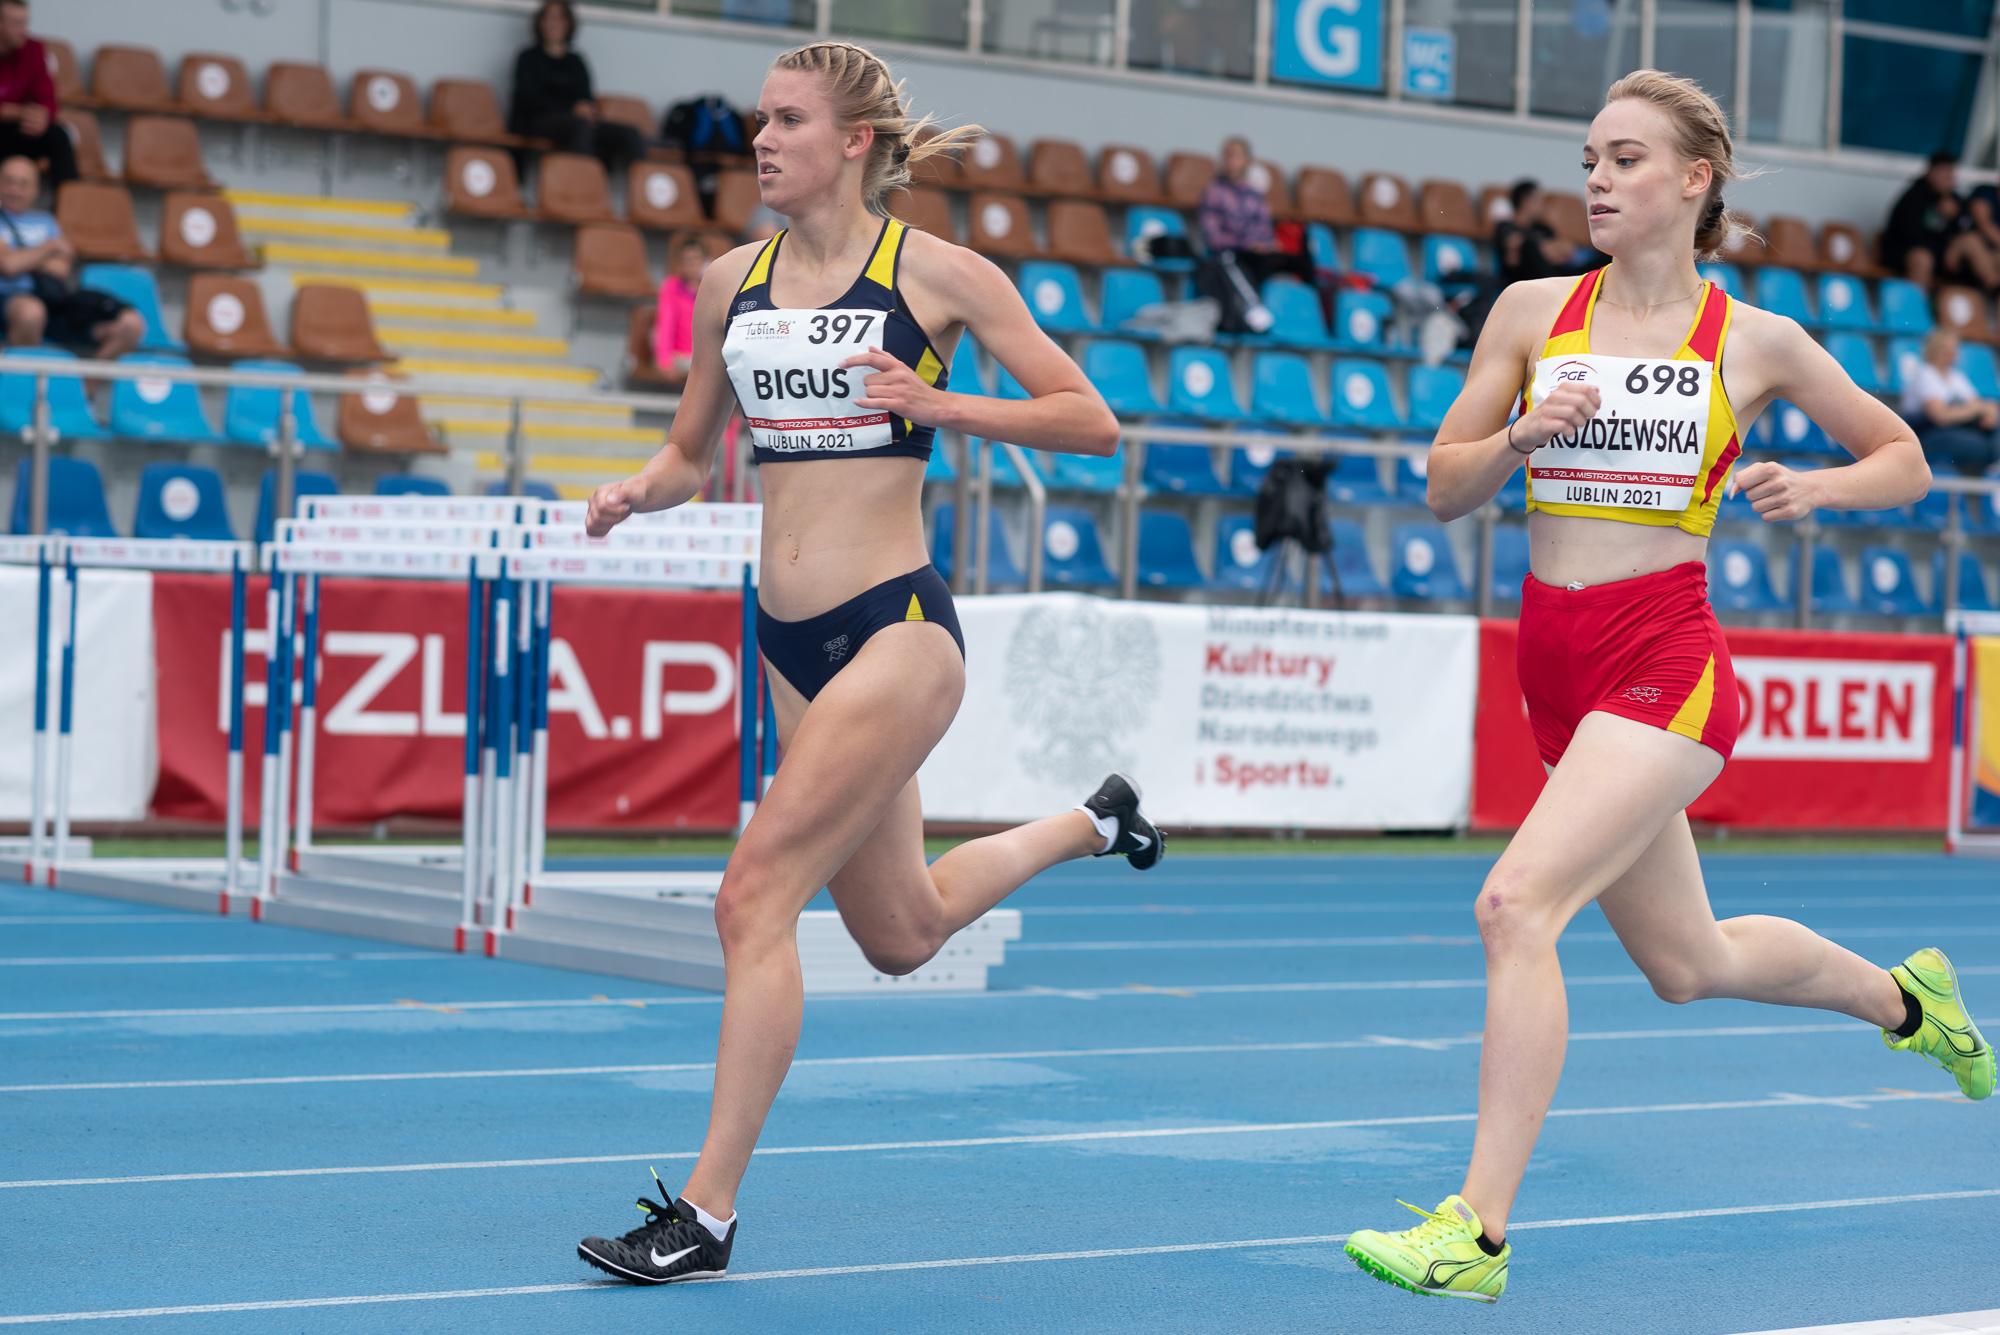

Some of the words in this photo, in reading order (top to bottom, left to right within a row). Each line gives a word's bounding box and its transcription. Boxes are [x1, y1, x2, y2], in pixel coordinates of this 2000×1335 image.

[1293, 0, 1361, 78] G
[807, 315, 876, 345] 397
[753, 368, 851, 400] BIGUS
[1557, 371, 1588, 382] PGE
[1625, 364, 1700, 397] 698
[832, 418, 862, 427] POLSKI
[864, 415, 883, 424] U20
[1536, 410, 1699, 454] ROZDŻEWSKA
[768, 435, 811, 449] LUBLIN
[817, 433, 854, 449] 2021
[1538, 470, 1552, 478] 75.
[1575, 472, 1639, 482] MISTRZOSTWA
[1640, 475, 1675, 484] POLSKI
[1676, 477, 1695, 485] U20
[1566, 486, 1618, 503] LUBLIN
[1623, 489, 1661, 506] 2021
[1205, 645, 1334, 687] Kultury
[219, 628, 764, 740] PZLA.P
[1201, 685, 1372, 714] Dziedzictwa
[1199, 719, 1379, 755] Narodowego
